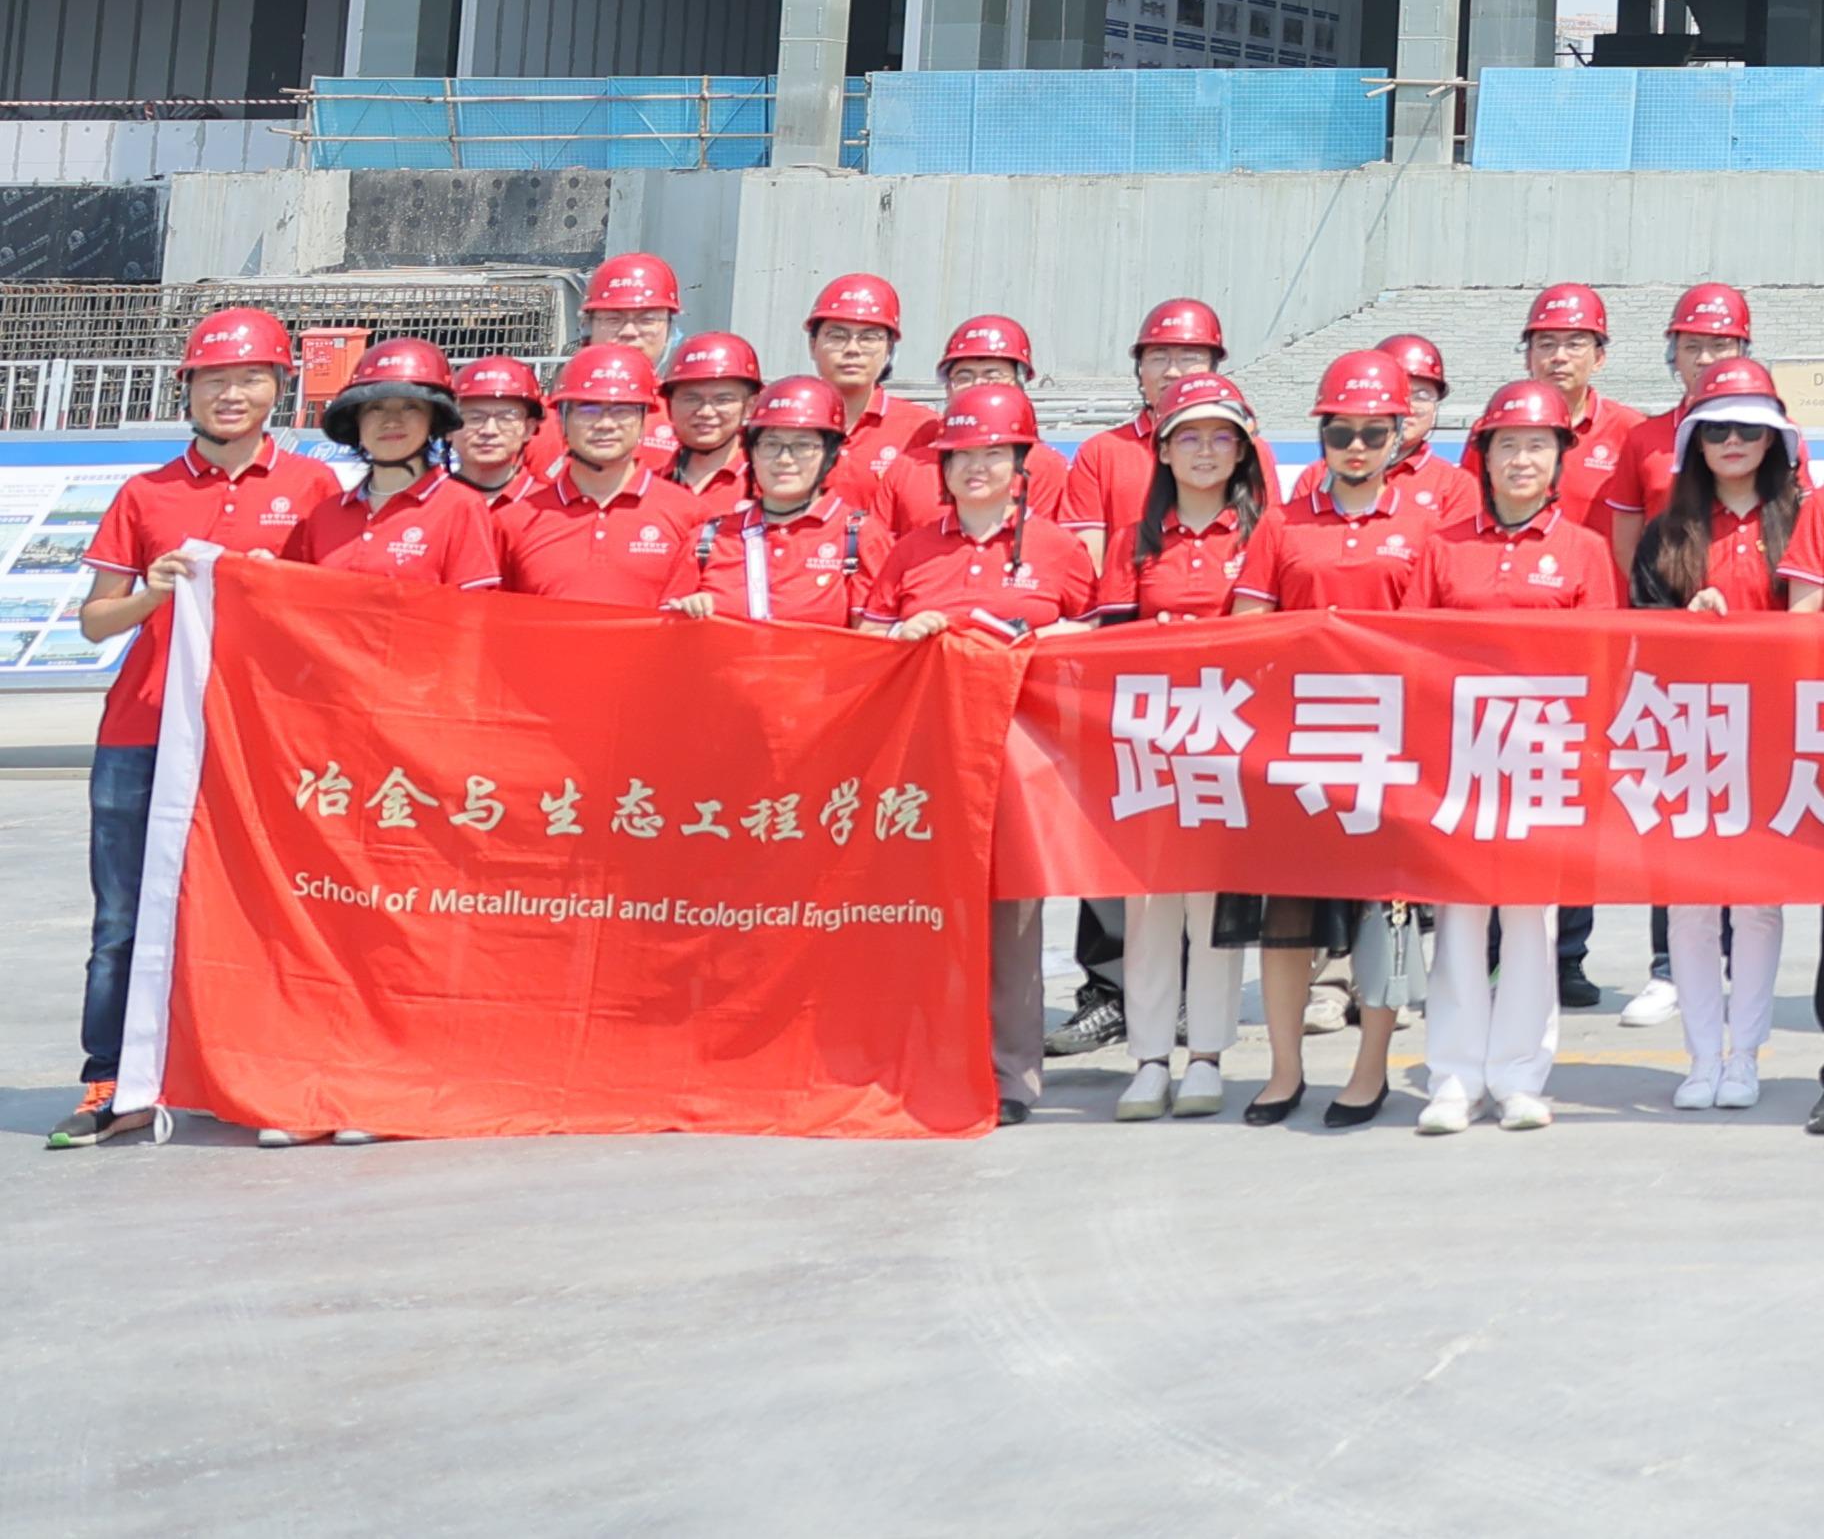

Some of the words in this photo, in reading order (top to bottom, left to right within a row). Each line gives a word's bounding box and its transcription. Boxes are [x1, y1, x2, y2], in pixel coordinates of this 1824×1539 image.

[294, 760, 933, 846] 冶金与生态工程学院
[292, 872, 379, 910] School
[384, 887, 419, 914] of
[429, 888, 614, 923] Metallurgical
[618, 898, 668, 922] and
[673, 899, 799, 931] Ecological
[803, 901, 944, 931] Engineering
